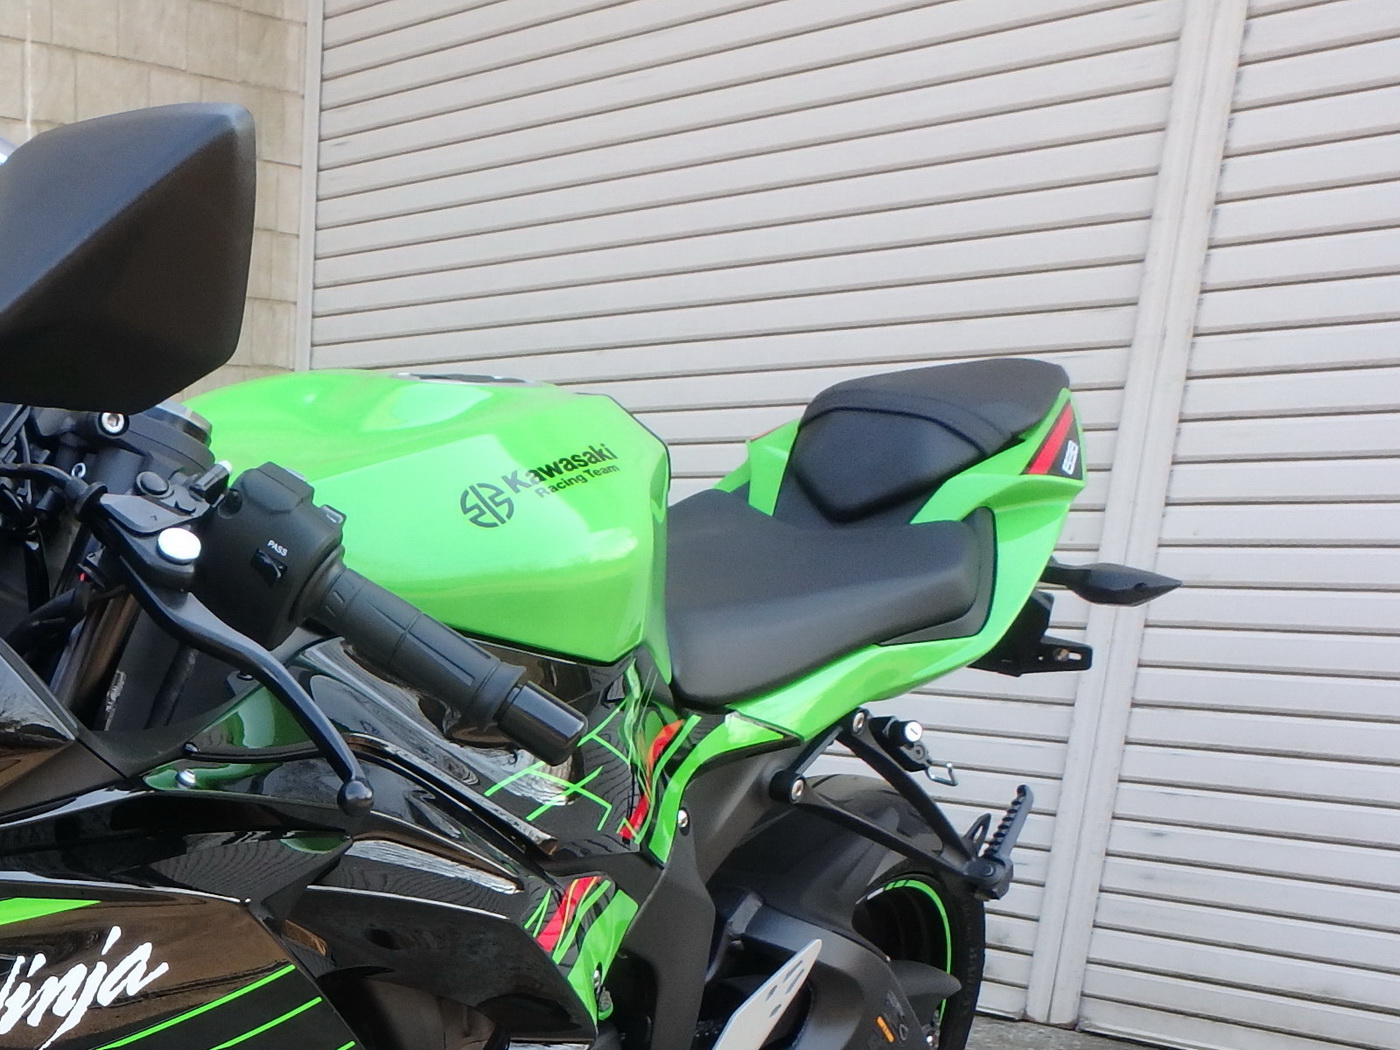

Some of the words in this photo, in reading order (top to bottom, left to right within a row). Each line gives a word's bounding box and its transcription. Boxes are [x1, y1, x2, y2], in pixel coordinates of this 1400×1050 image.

[501, 443, 618, 494] Kawasaki
[535, 474, 587, 498] Racing
[582, 464, 621, 479] Team
[267, 539, 288, 557] PASS
